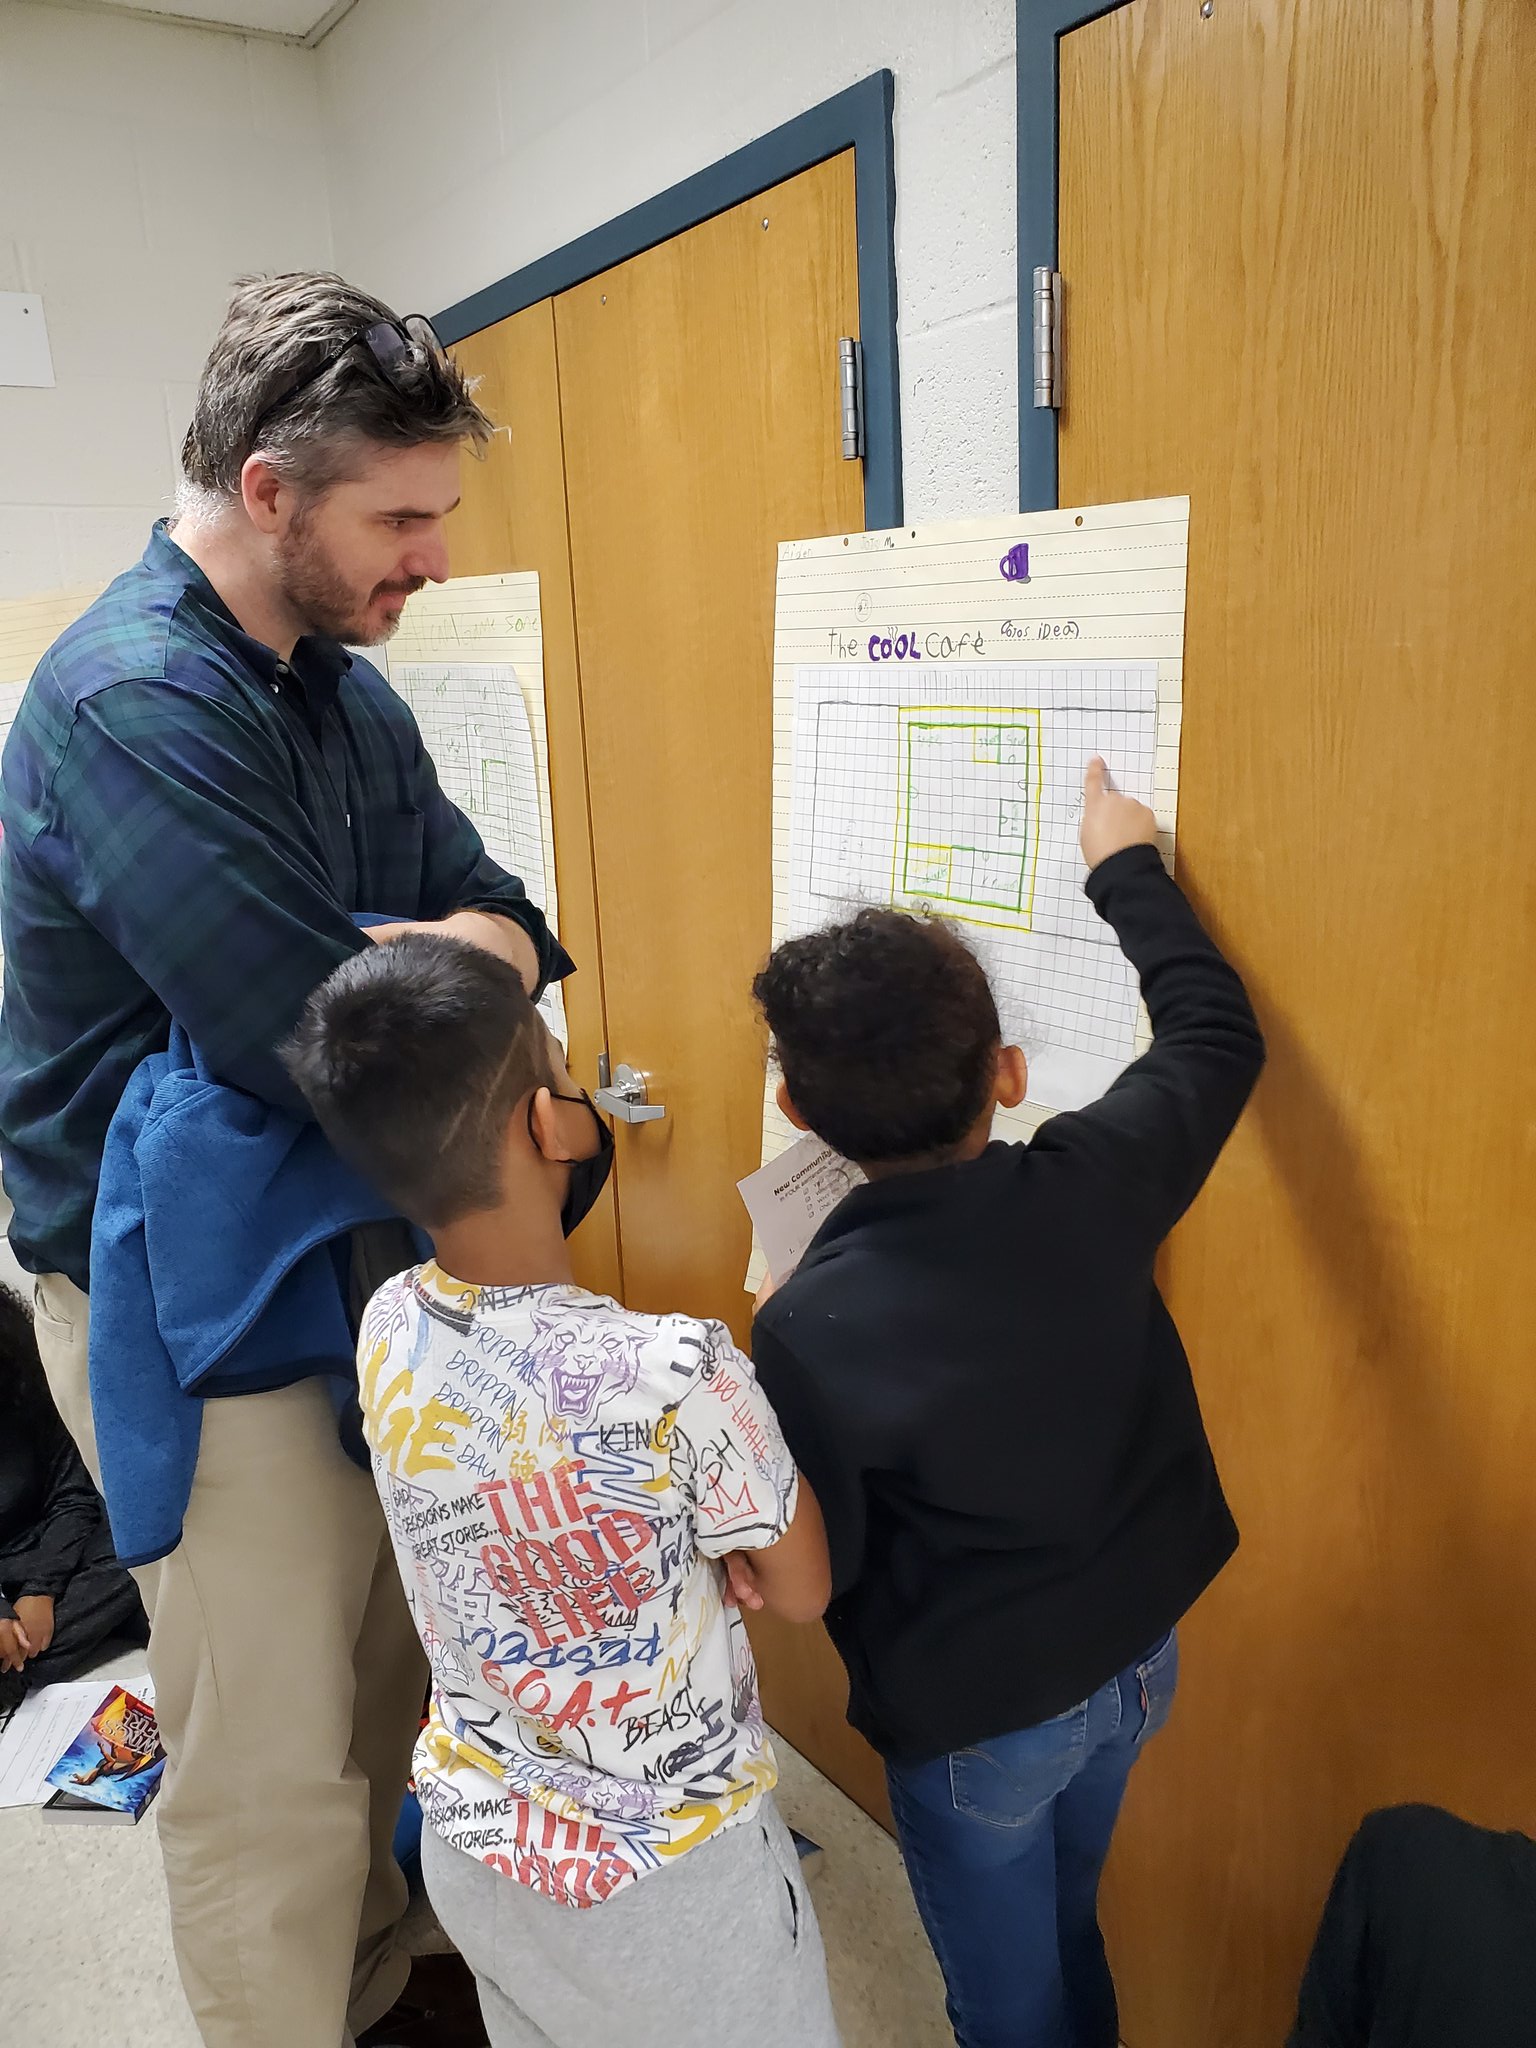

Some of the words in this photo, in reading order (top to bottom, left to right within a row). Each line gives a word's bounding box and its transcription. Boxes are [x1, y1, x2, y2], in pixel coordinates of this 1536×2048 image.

[828, 628, 858, 658] The
[868, 632, 921, 661] COOL
[773, 1181, 791, 1196] New
[791, 1149, 832, 1183] Community
[601, 1416, 671, 1454] KING
[451, 1492, 486, 1519] MAKE
[475, 1459, 602, 1536] THE
[480, 1509, 653, 1597] GOOD
[521, 1561, 657, 1648] LIFE
[473, 1798, 513, 1821] MAKE
